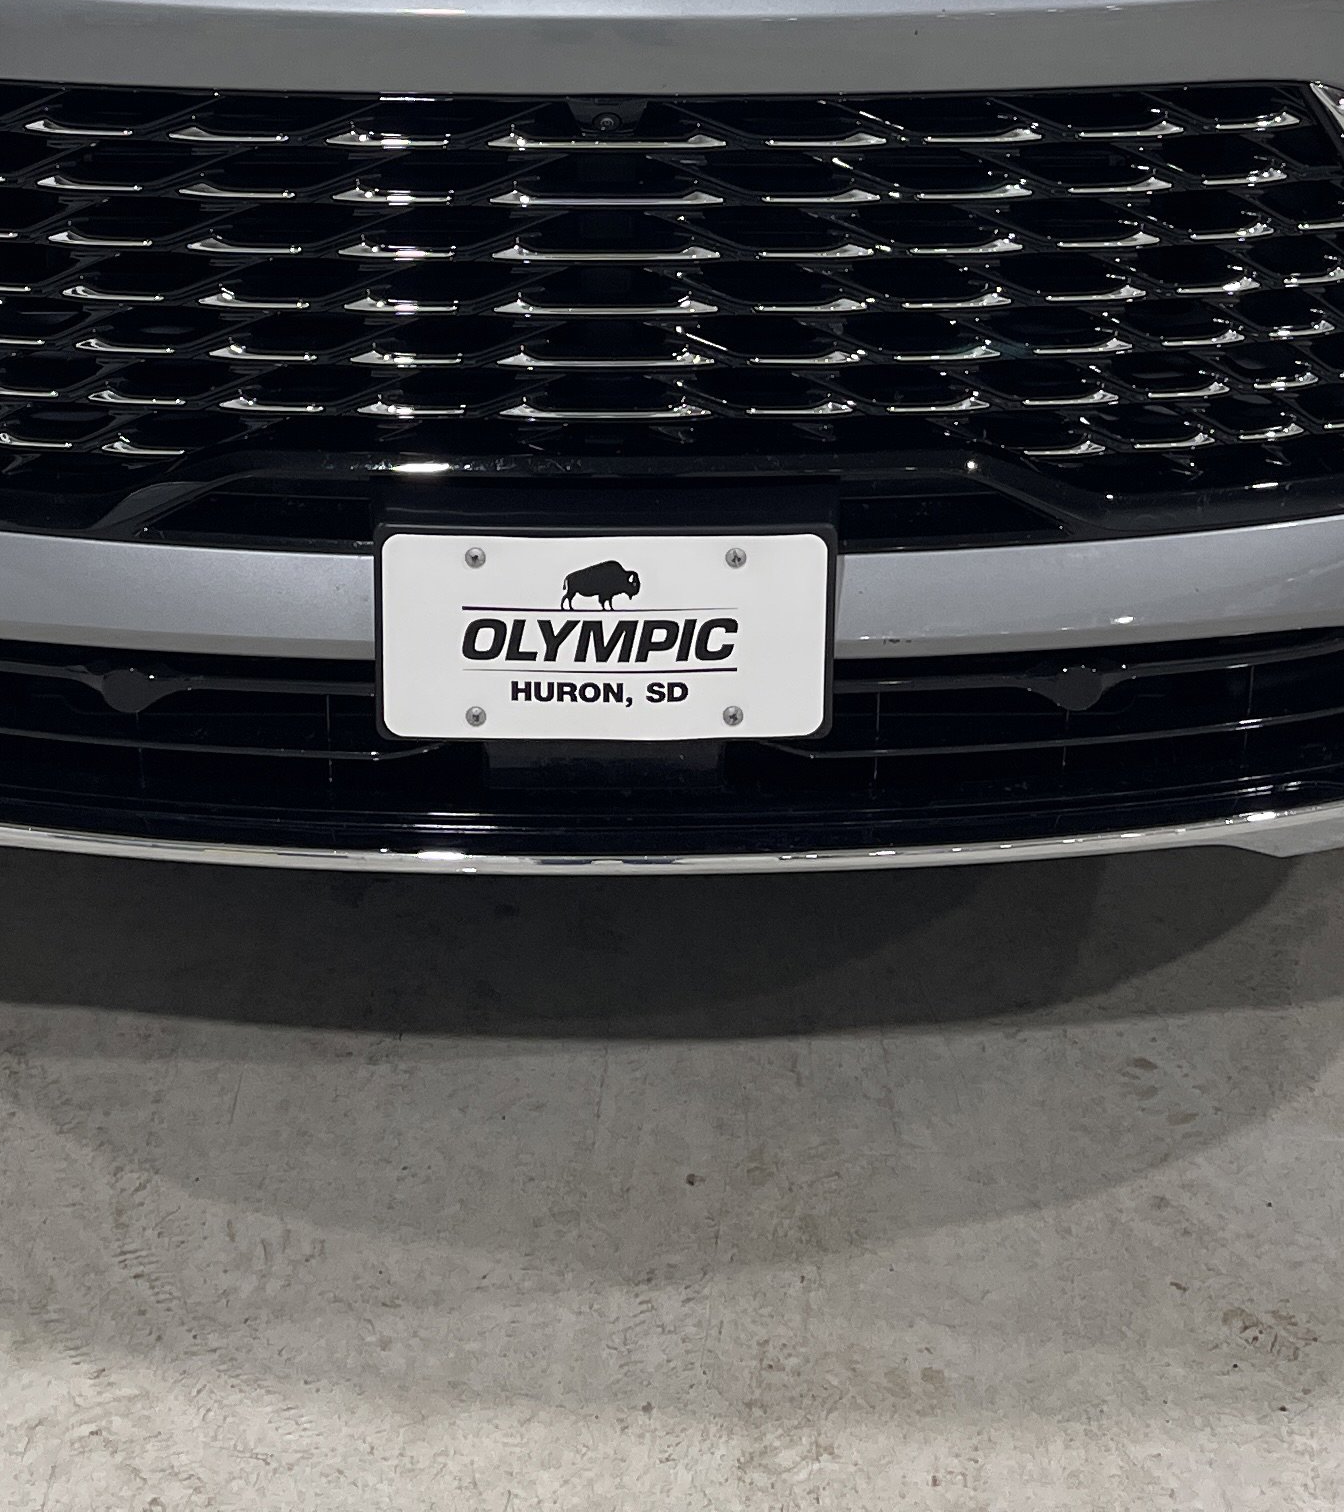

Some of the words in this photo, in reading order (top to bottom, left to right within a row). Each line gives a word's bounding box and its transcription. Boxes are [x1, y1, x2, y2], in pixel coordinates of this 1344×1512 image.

[461, 617, 739, 663] OLYMPIC
[510, 680, 633, 707] HURON,
[645, 680, 689, 703] SD
